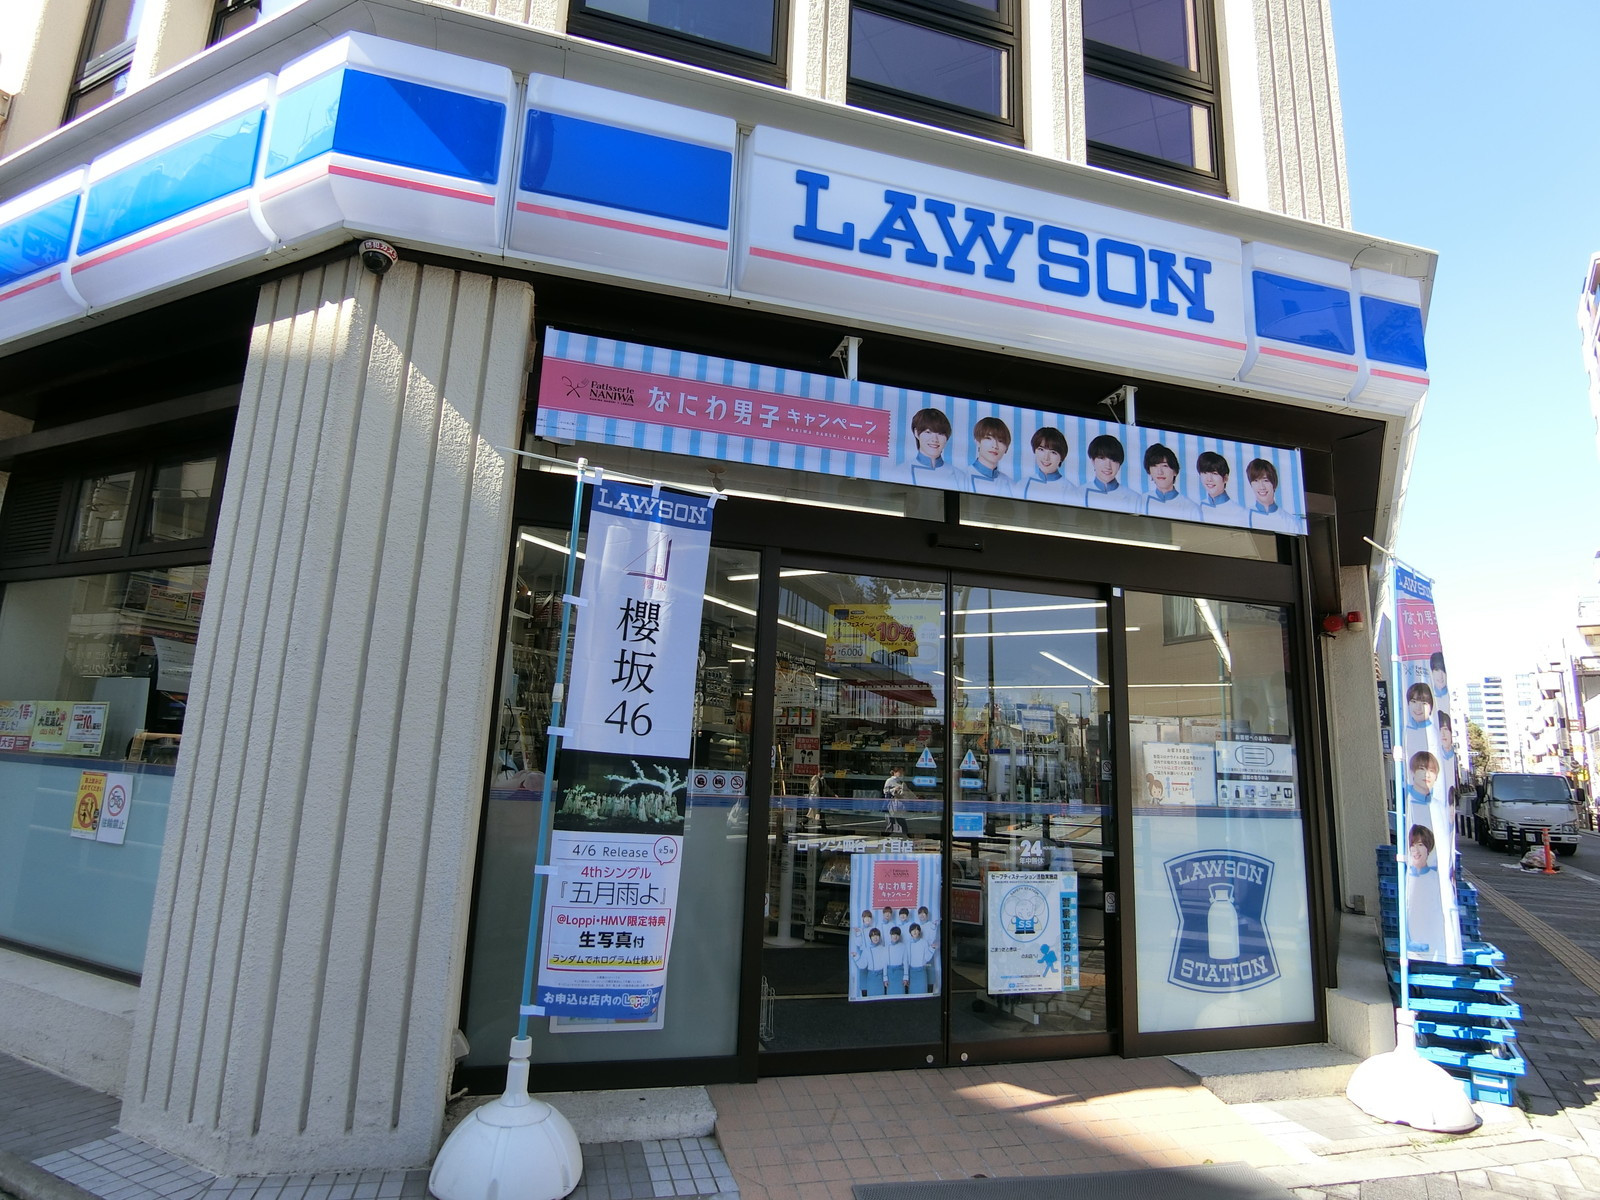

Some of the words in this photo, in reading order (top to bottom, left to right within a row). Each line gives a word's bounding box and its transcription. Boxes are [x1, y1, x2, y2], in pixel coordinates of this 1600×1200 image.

[793, 169, 1215, 323] LAWSON
[589, 389, 635, 404] NANIWA
[590, 380, 634, 395] Patisserie
[647, 386, 780, 429] なにわ男子
[787, 408, 877, 435] キャンペーン
[598, 488, 708, 525] LAWSON
[604, 597, 662, 736] 櫻坂46
[572, 844, 596, 856] 4/6
[602, 846, 649, 858] Release
[797, 840, 914, 853] ローソン四谷一丁目店
[1020, 839, 1042, 857] 24
[581, 866, 652, 879] 4thシングル
[1175, 859, 1265, 885] LAWSON
[560, 881, 666, 906] 『五月雨よ』
[878, 882, 914, 890] なにわ男子
[1018, 920, 1032, 928] SS
[578, 930, 645, 949] 生写真付
[1180, 955, 1269, 983] STATION
